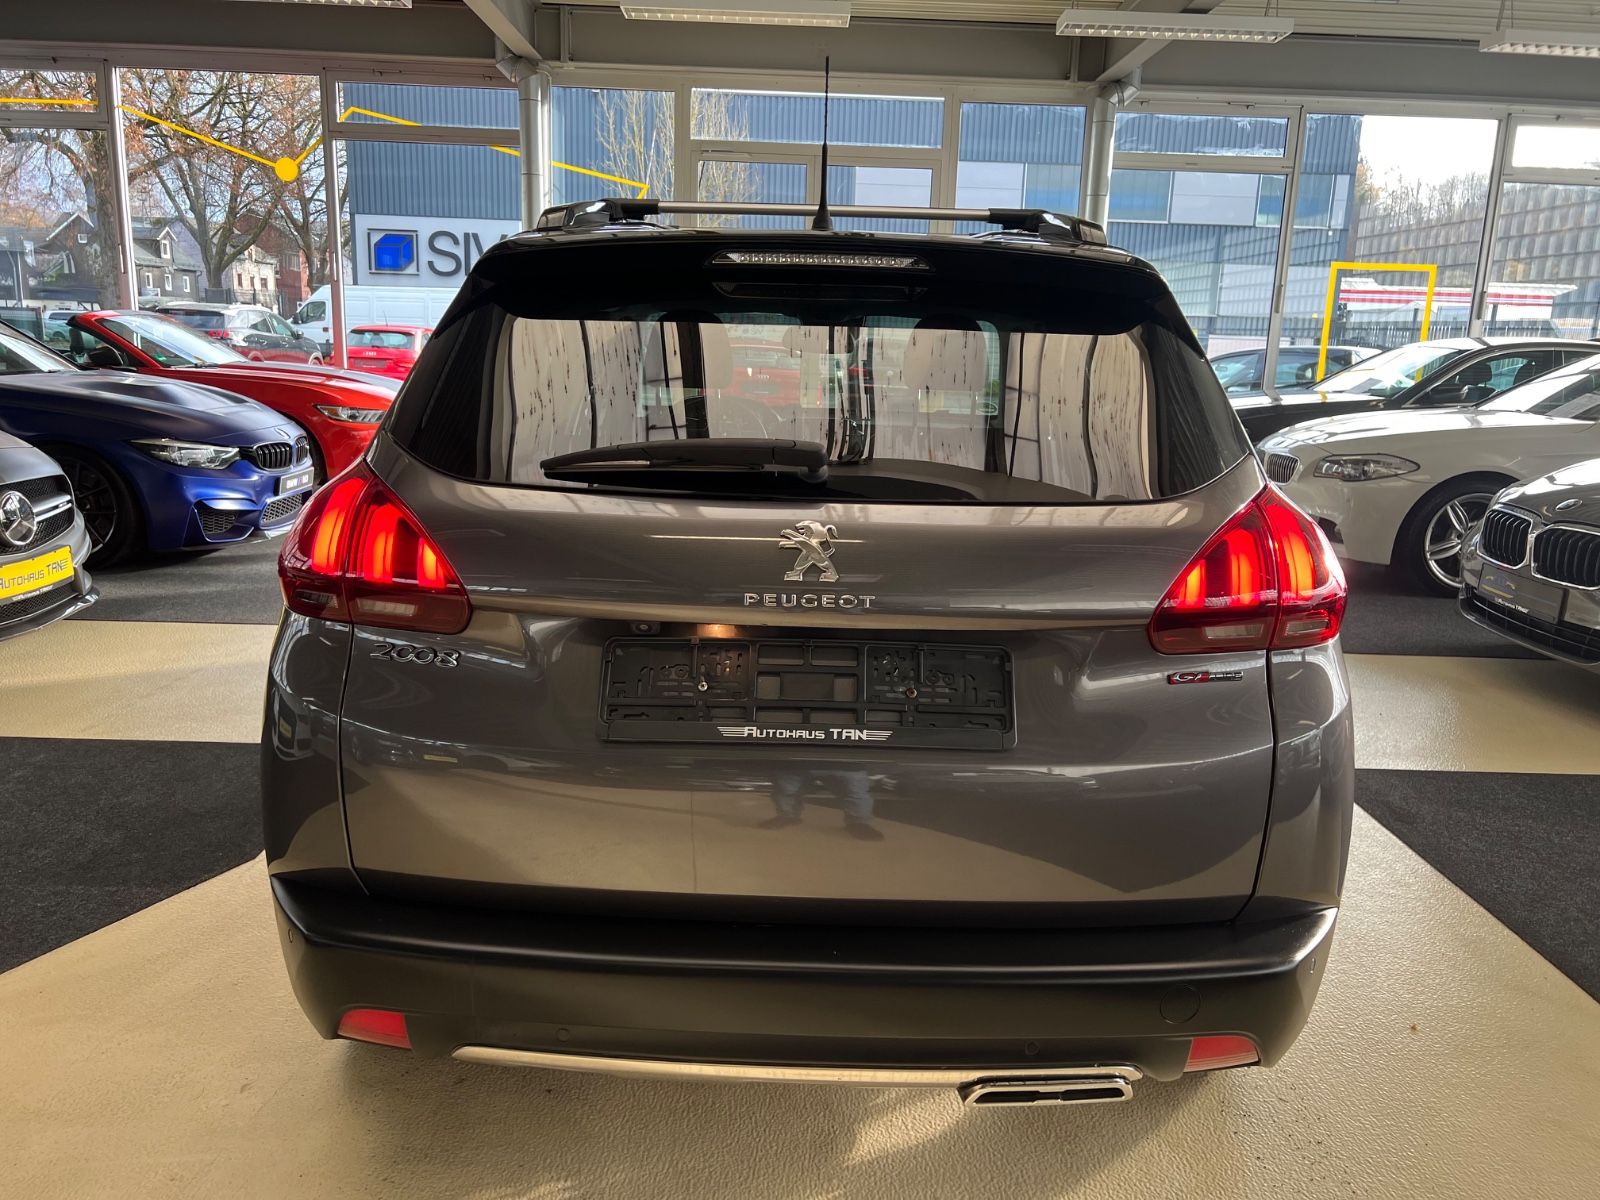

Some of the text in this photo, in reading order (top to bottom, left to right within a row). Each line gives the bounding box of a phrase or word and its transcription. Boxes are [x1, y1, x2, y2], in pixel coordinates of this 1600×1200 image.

[743, 592, 876, 609] PEUGEOT
[369, 642, 461, 668] 2008
[743, 726, 867, 741] AUTOHAUS TAN
